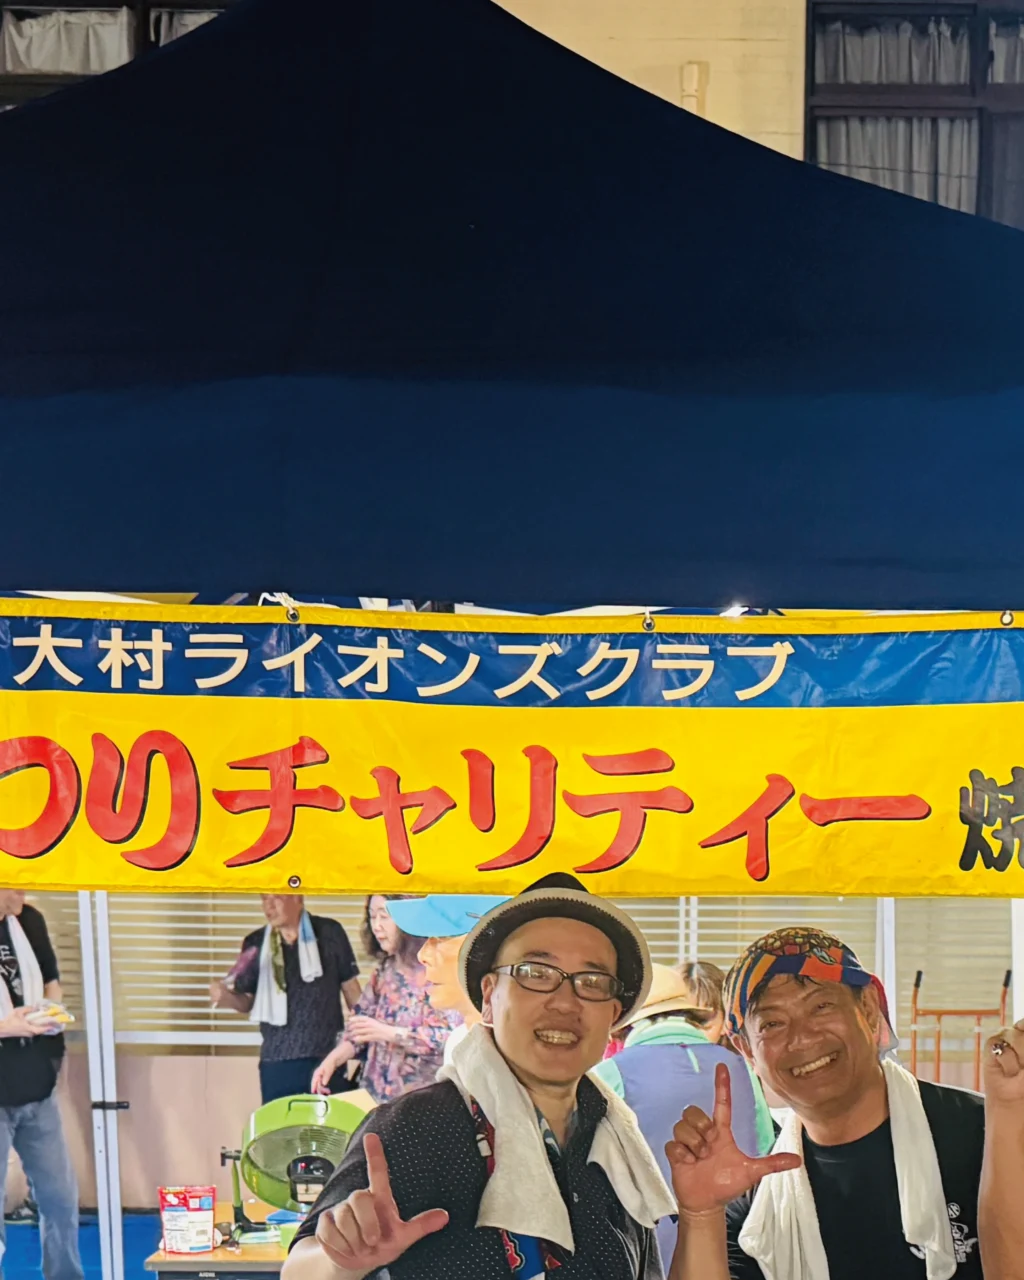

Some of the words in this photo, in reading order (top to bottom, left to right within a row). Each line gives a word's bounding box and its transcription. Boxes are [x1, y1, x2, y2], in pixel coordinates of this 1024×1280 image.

[13, 623, 795, 702] 大村ライオンズクラブ
